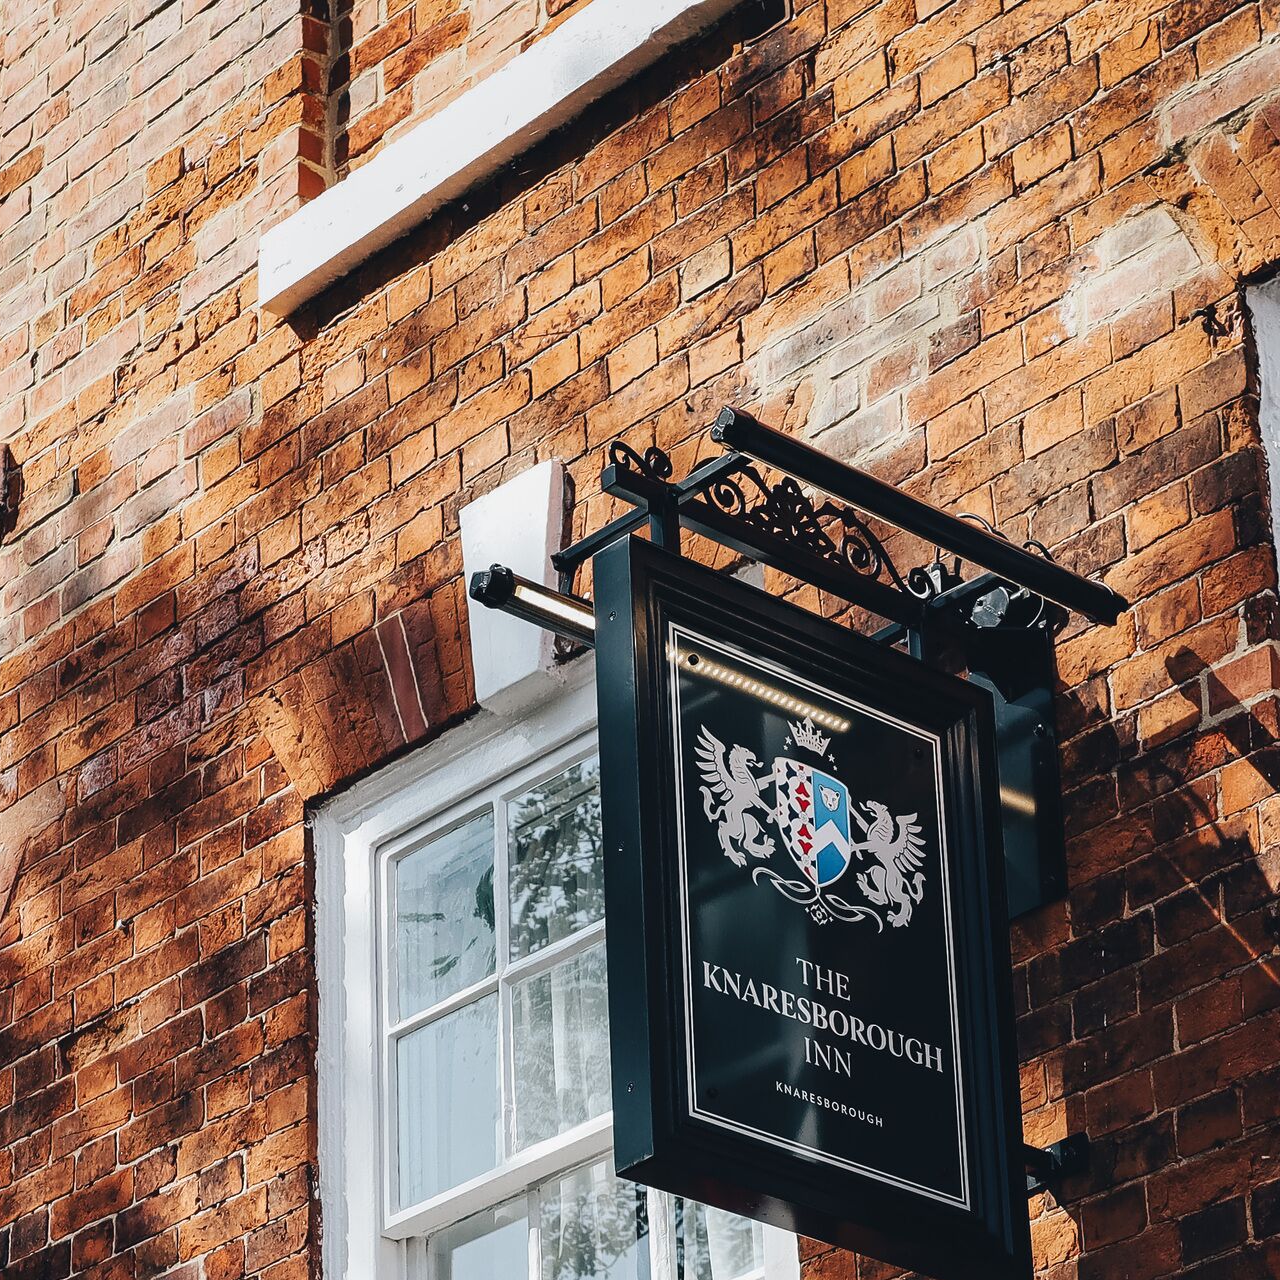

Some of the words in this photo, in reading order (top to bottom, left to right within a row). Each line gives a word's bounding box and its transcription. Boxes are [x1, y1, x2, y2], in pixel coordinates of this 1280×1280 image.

[795, 957, 851, 1002] THE
[702, 960, 944, 1073] KNARESBOROUGH
[804, 1036, 852, 1078] INN
[775, 1081, 883, 1128] KNARESBOROUGH
